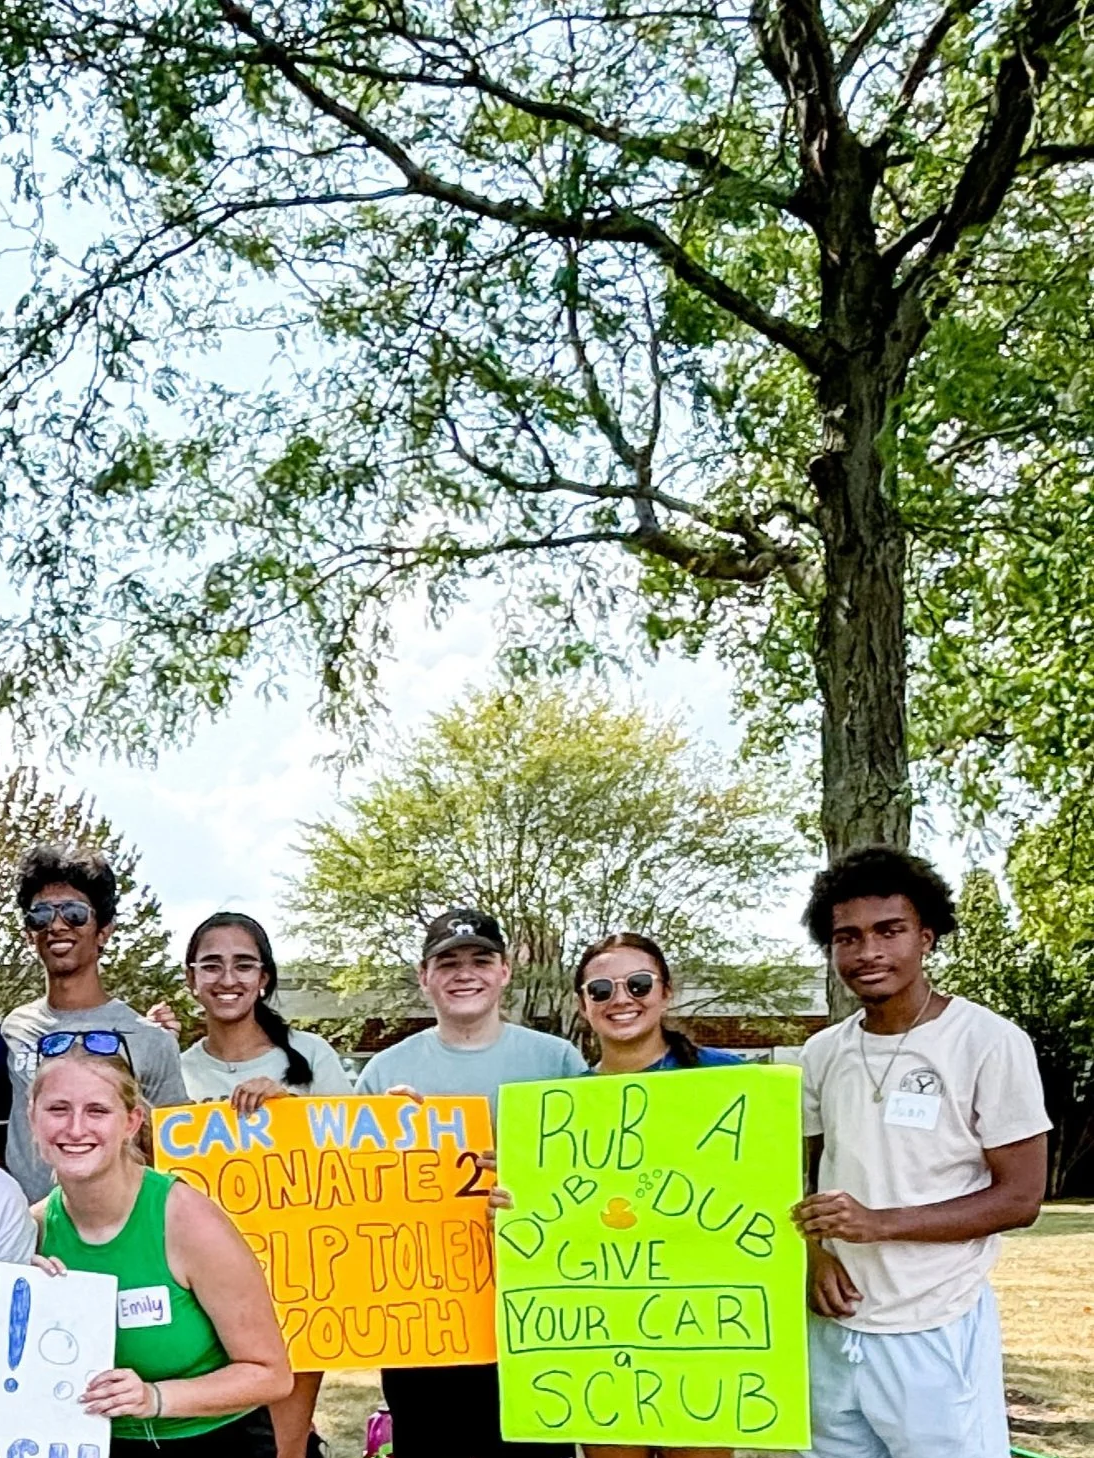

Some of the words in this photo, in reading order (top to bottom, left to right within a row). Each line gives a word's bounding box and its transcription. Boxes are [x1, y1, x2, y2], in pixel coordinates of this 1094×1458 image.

[159, 1105, 276, 1158] CAR
[307, 1101, 468, 1151] WASH
[696, 1093, 746, 1162] A
[454, 1152, 492, 1198] 2
[498, 1174, 598, 1260] DUB
[651, 1169, 776, 1258] DUB
[356, 1218, 496, 1294] TOLED
[557, 1239, 670, 1281] GIVE
[120, 1294, 164, 1321] Emily
[506, 1295, 611, 1344] YOUR
[637, 1292, 752, 1341] CAR
[613, 1350, 632, 1369] a
[531, 1369, 779, 1433] SCRUB
